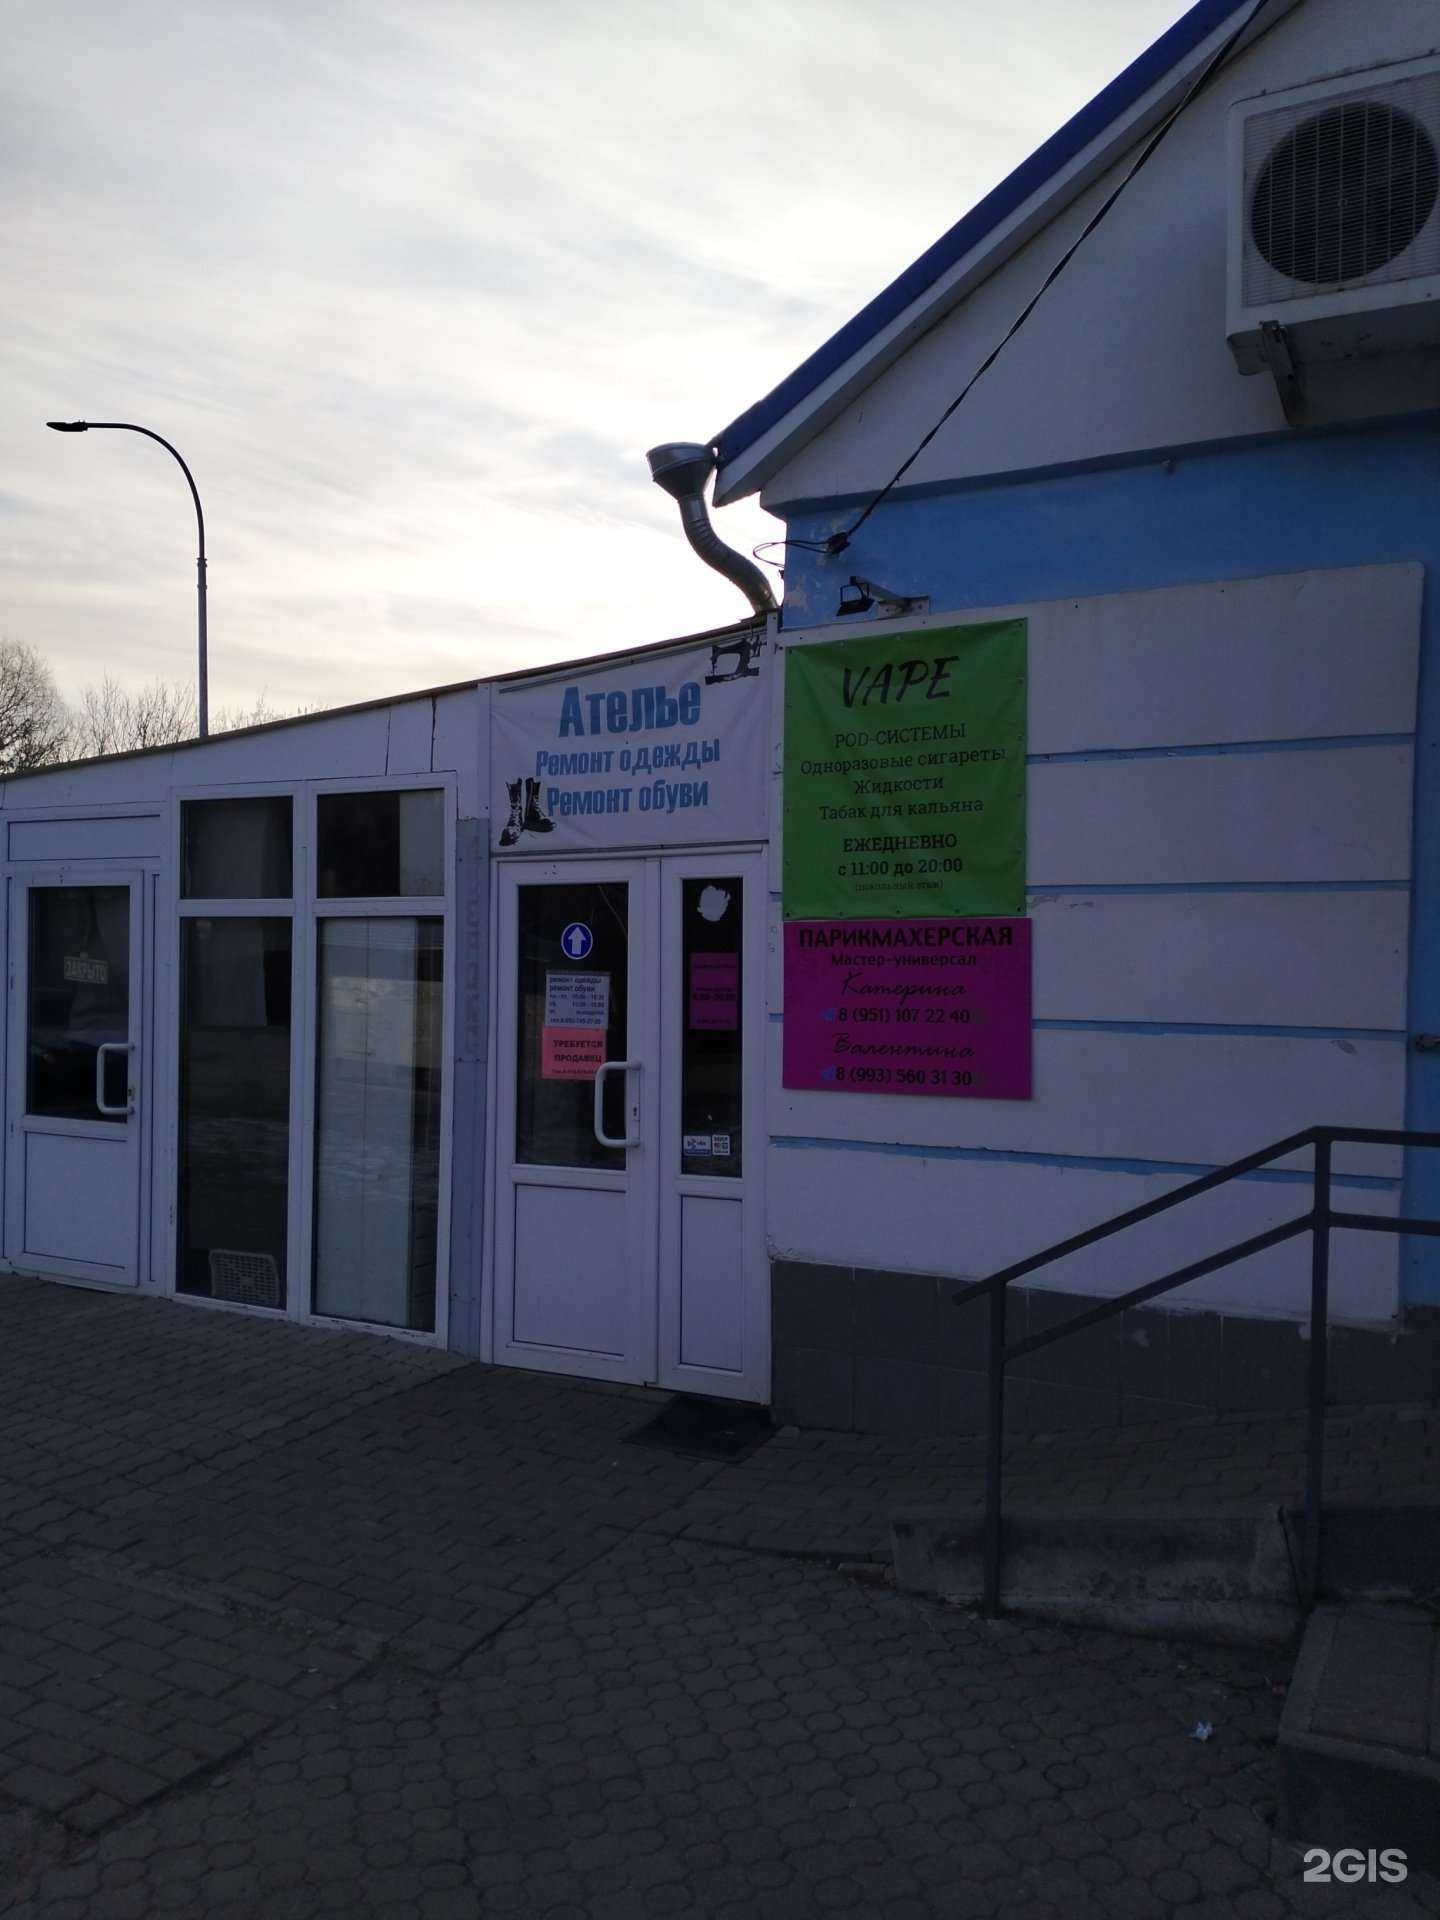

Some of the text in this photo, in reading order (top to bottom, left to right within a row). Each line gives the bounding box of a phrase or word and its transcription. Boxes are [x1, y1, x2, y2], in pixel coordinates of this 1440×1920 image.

[843, 656, 959, 707] VAPE
[558, 682, 701, 737] Ателье
[834, 723, 966, 748] POD-СИСТЕМЫ
[536, 738, 720, 776] Ремонт одежды
[801, 748, 1006, 775] Одноразовые сигареты
[854, 777, 943, 795] Жидкости
[547, 779, 708, 817] Ремонт обуви
[819, 800, 984, 820] Табак для кальяна
[843, 833, 957, 854] ЕЖЕДНЕВНО
[838, 858, 963, 876] с 11:00 до 20:00
[799, 926, 1012, 947] ПАРИКМАХЕРСКАЯ
[831, 953, 977, 967] Мастер-универсал
[841, 971, 967, 1005] Катерина
[838, 1008, 970, 1023] 8 (951) 107 22 40
[831, 1032, 976, 1057] Валентина
[835, 1067, 845, 1080] 8
[850, 1067, 892, 1083] (993)
[931, 1070, 947, 1085] 31
[952, 1071, 972, 1086] 30
